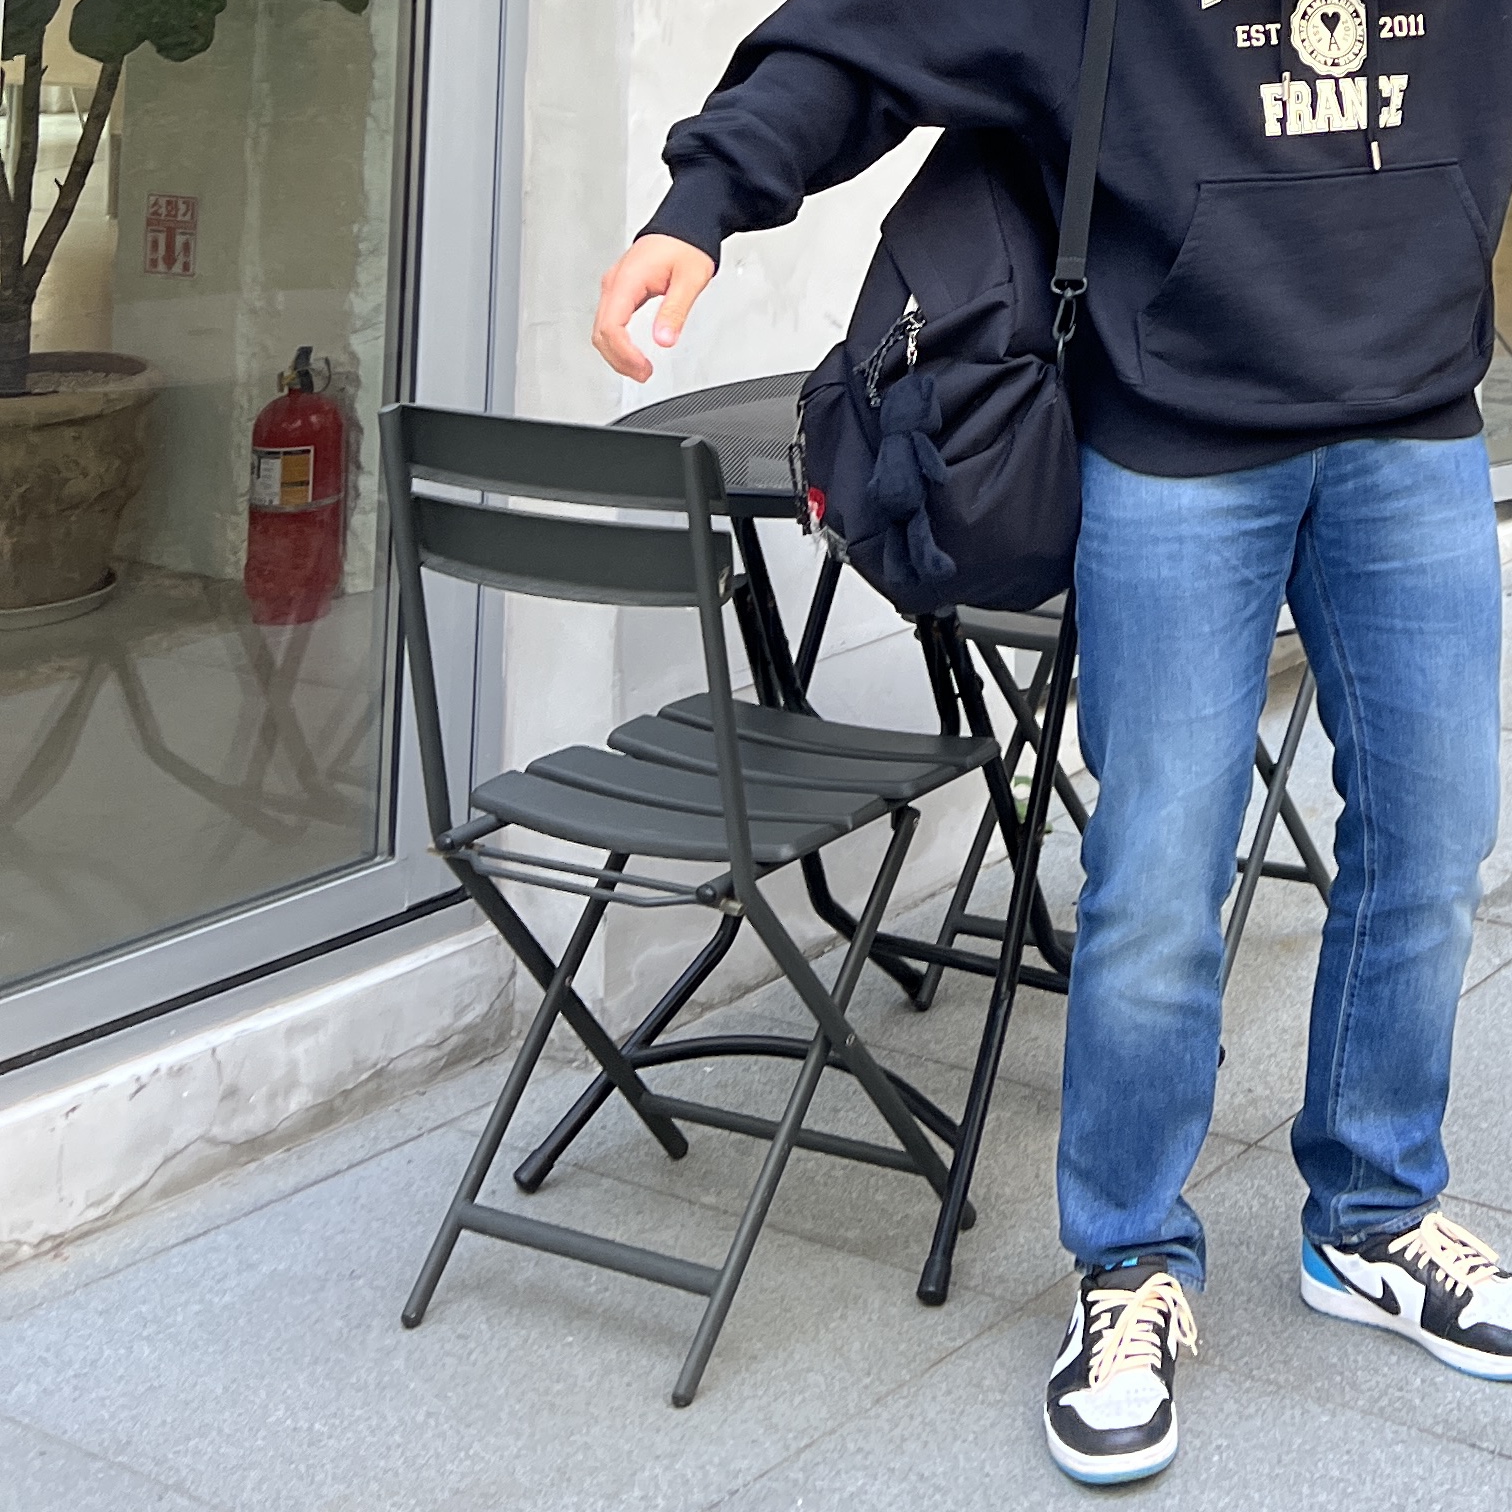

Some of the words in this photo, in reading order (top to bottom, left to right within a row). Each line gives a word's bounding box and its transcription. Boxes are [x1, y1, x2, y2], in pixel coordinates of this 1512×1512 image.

[1235, 22, 1281, 48] EST
[1378, 13, 1425, 39] 2011
[149, 197, 194, 220] 소화기
